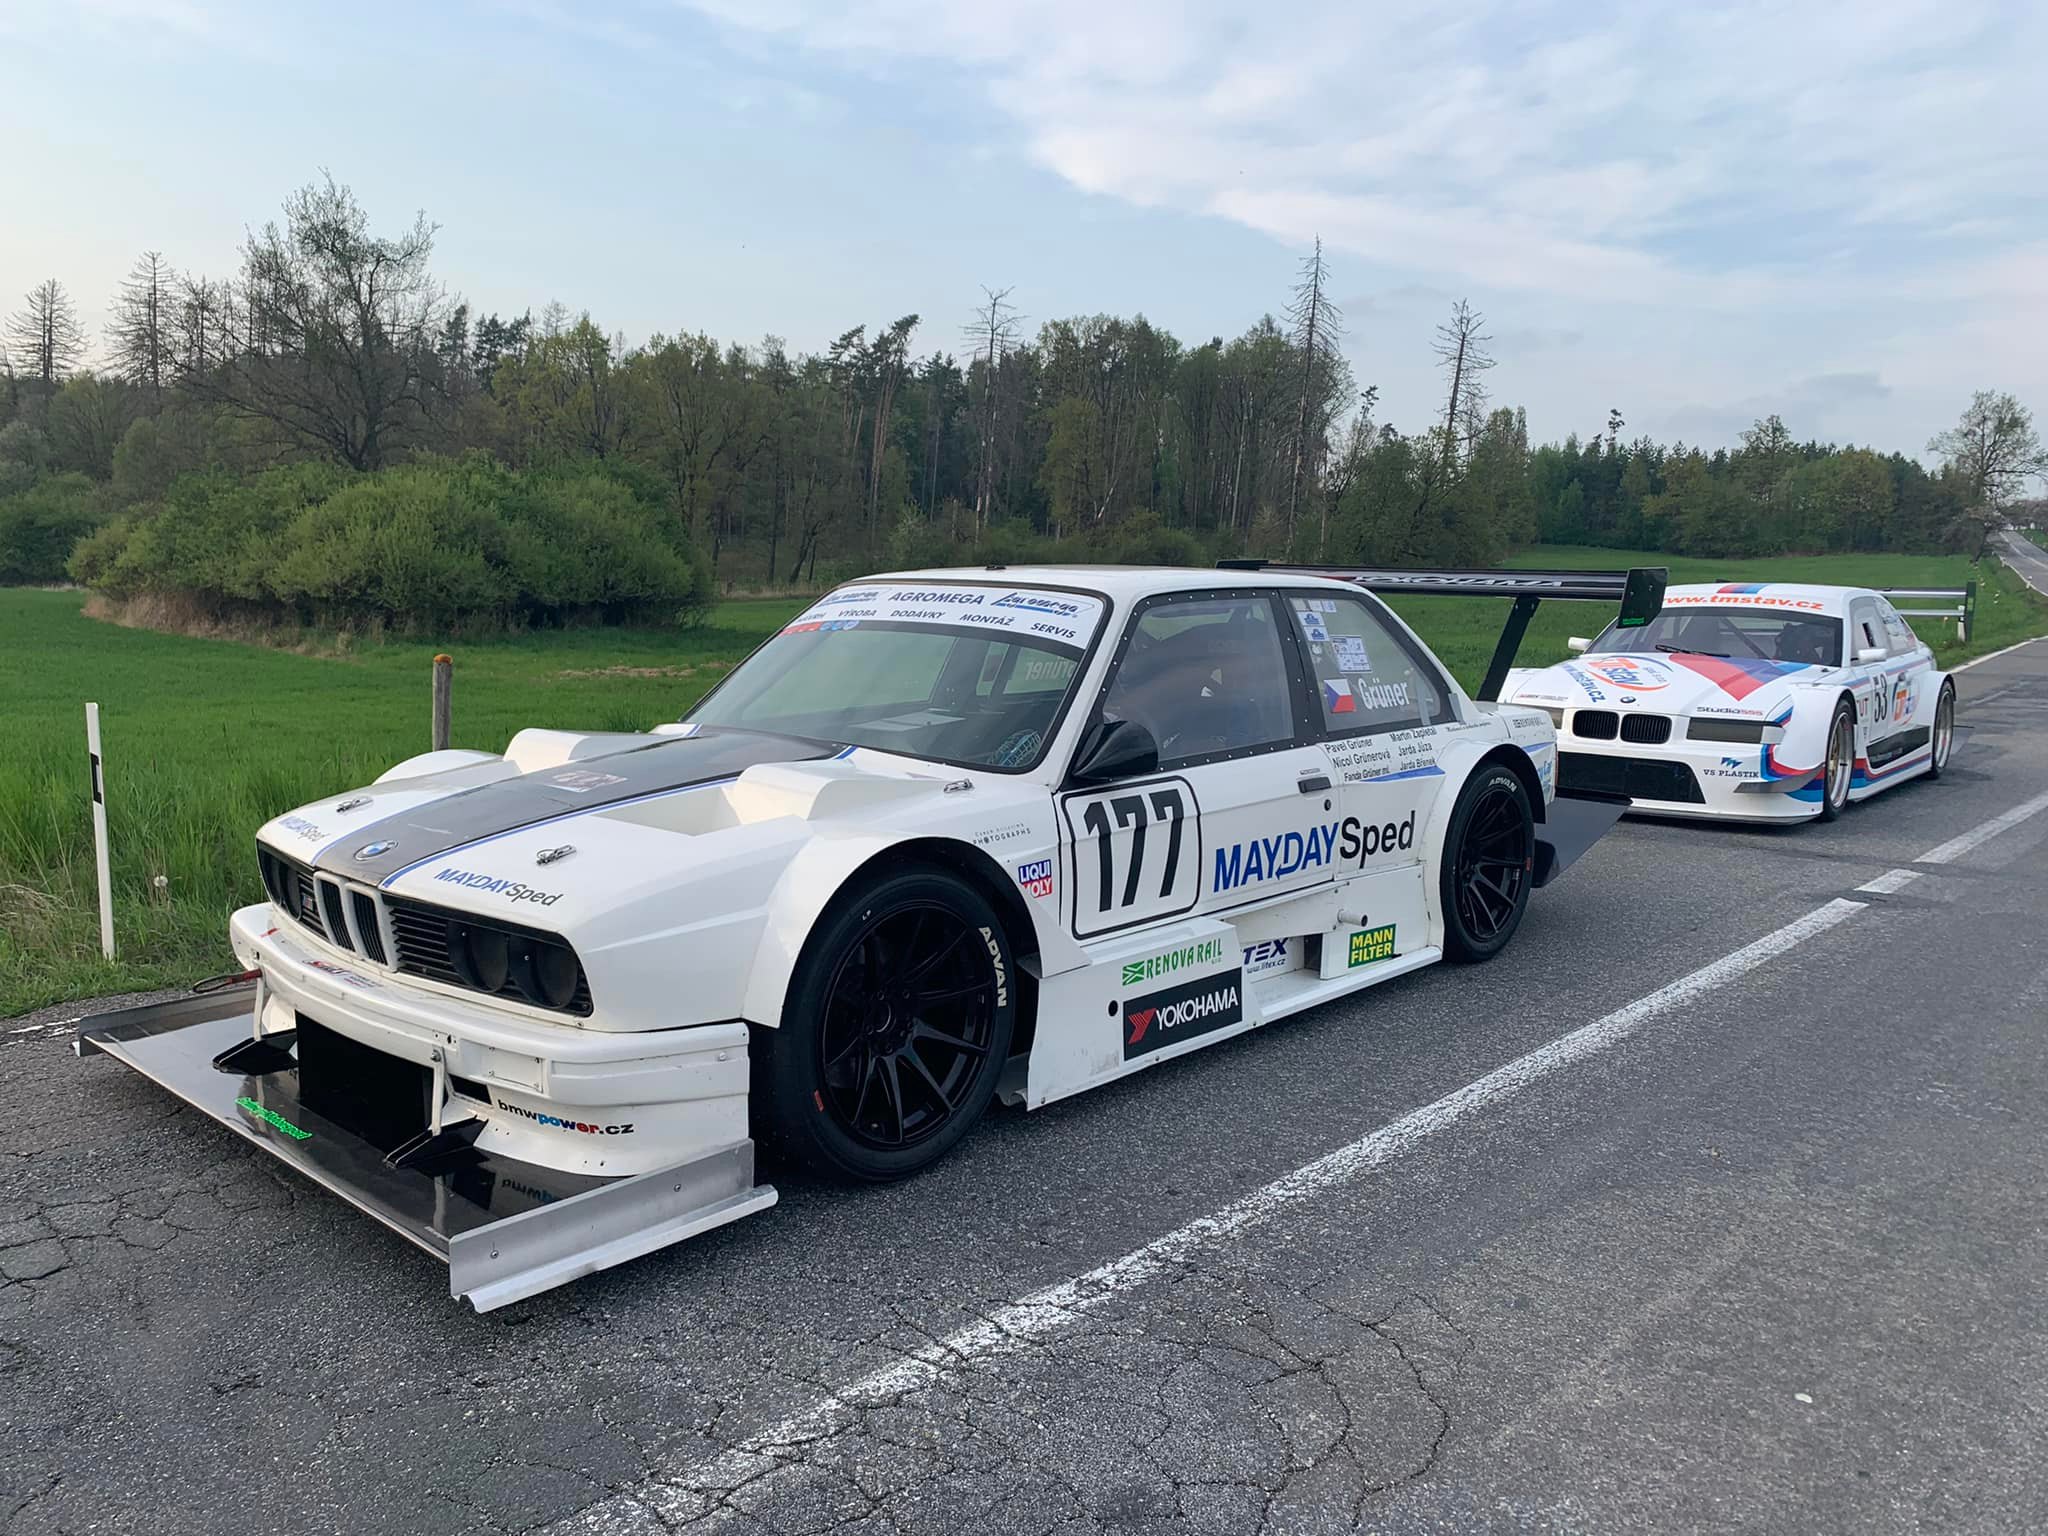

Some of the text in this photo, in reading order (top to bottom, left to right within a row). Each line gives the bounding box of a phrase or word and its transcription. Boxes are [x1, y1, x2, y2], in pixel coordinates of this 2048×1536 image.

[888, 592, 985, 605] AGROMEGA
[890, 608, 946, 619] DODÁVKY
[960, 611, 1016, 626] MONTÁŽ
[1031, 622, 1077, 638] SERVIS
[1358, 677, 1410, 710] Grüner
[1325, 738, 1373, 753] Pavel Grüner
[1389, 732, 1412, 743] Martin
[1332, 754, 1353, 768] Nicol
[1719, 770, 1760, 778] PLASTIK
[1487, 777, 1518, 793] ADVAN
[1083, 789, 1184, 912] 177
[1213, 810, 1416, 893] MAYDAYSped
[1019, 861, 1052, 883] LIQUI
[434, 868, 564, 906] MAYDAYSped
[1352, 928, 1393, 949] MANN
[1146, 938, 1222, 980] RENOVA RAIL
[1351, 942, 1392, 964] FILTER
[978, 926, 1008, 1008] ADVAN
[1156, 986, 1238, 1030] YOKOHAMA
[498, 1099, 634, 1135] bmwpower.cz
